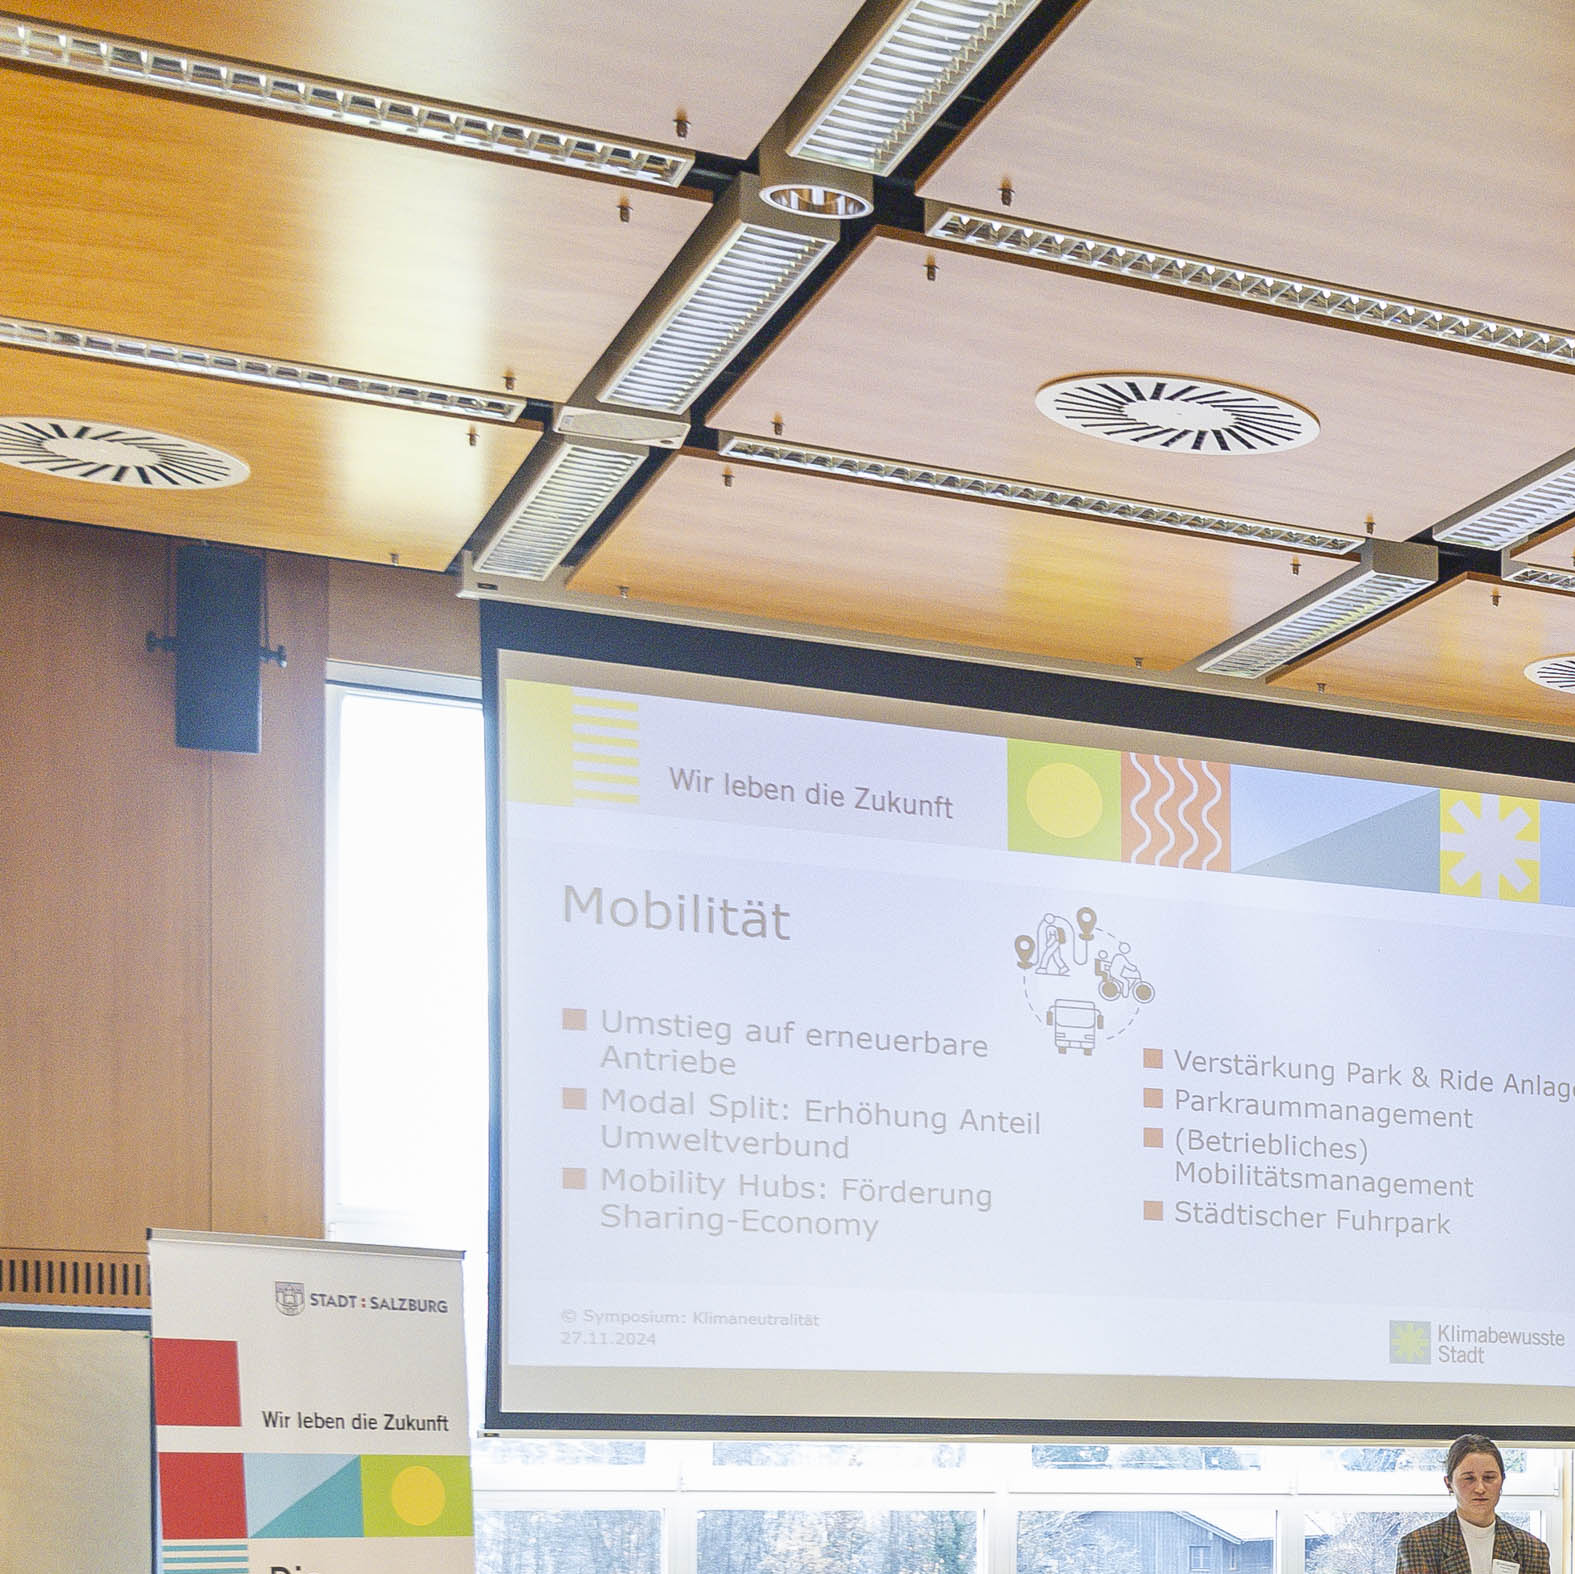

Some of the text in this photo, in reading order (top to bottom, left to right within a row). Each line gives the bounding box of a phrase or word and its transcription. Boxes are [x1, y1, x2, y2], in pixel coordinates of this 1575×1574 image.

[669, 766, 954, 819] Wir leben die Zukunft
[563, 885, 791, 941] Mobilität
[601, 1009, 989, 1058] Umstieg auf erneuerbare
[600, 1045, 737, 1076] Antriebe
[1174, 1049, 1336, 1086] Verstärkung
[1347, 1062, 1402, 1087] Park
[1412, 1067, 1430, 1088] &
[1440, 1069, 1494, 1093] Ride
[602, 1088, 1041, 1136] Modal Split: Erhöhung Anteil
[1175, 1088, 1473, 1129] Parkraummanagement
[601, 1124, 850, 1160] Umweltverbund
[1175, 1127, 1369, 1165] (Betriebliches)
[602, 1168, 992, 1213] Mobility Hubs: Förderung
[1175, 1161, 1474, 1199] Mobilitätsmanagement
[600, 1204, 879, 1242] Sharing-Economy
[1175, 1201, 1451, 1238] Städtischer Fuhrpark
[310, 1293, 357, 1308] STADT
[370, 1296, 448, 1313] SALZBURG
[584, 1309, 687, 1326] Symposium:
[693, 1311, 821, 1327] Klimaneutralität
[560, 1332, 656, 1346] 27.11.2024
[1438, 1324, 1566, 1348] Klimabewusste
[1438, 1345, 1485, 1364] Stadt
[262, 1410, 449, 1432] Wir leben die Zukunft
